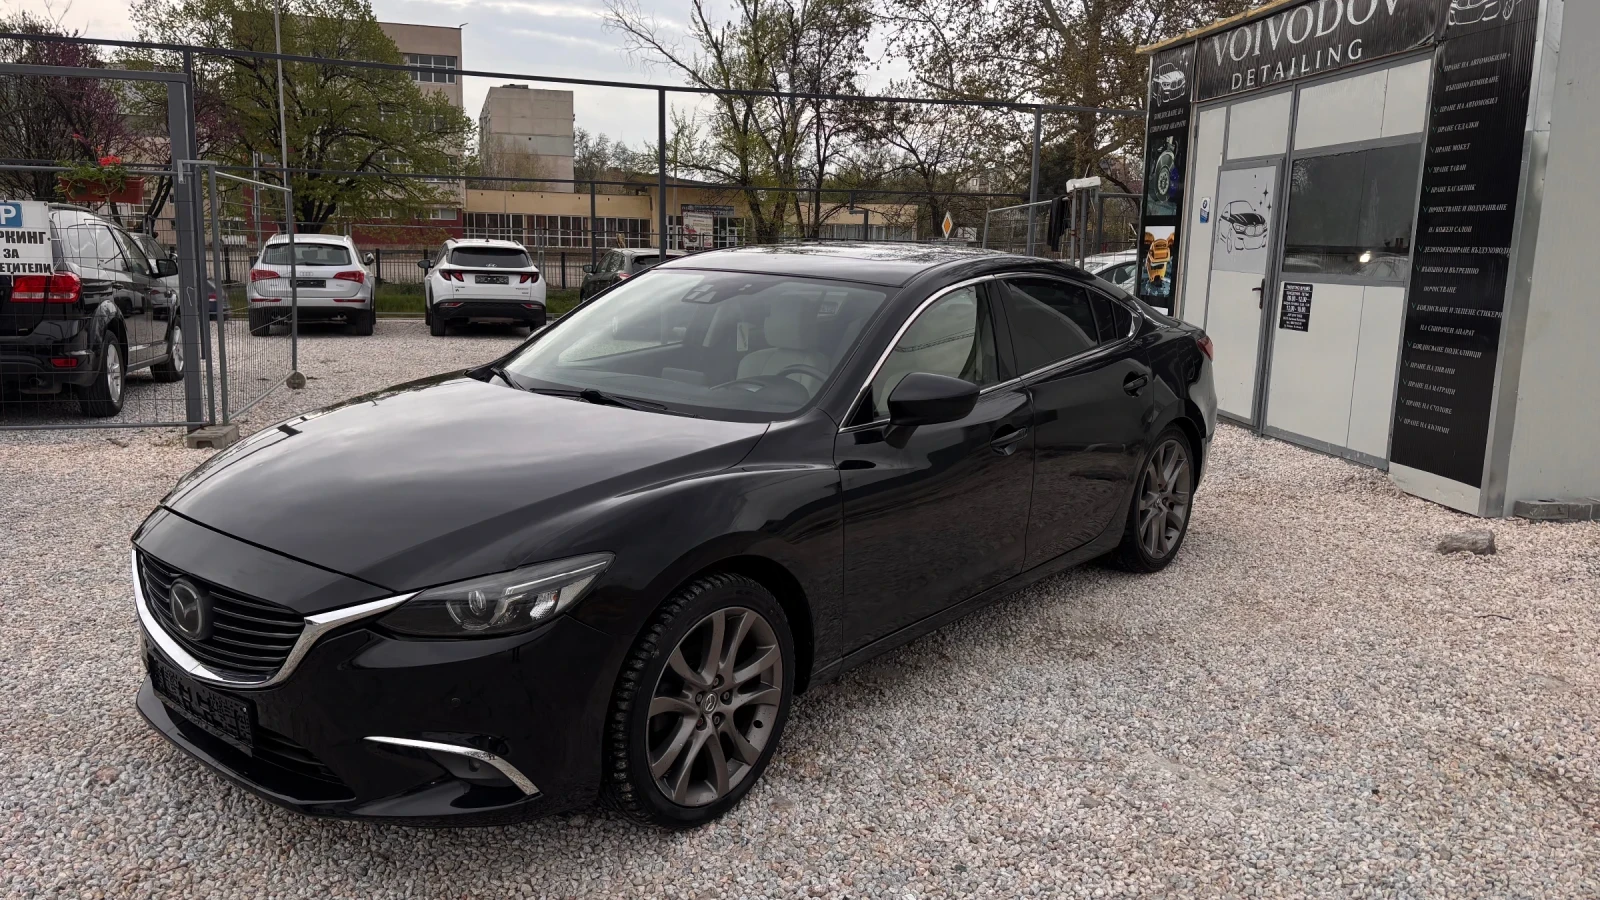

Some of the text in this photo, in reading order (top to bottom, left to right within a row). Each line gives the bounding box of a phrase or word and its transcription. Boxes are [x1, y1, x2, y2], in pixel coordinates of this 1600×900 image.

[1231, 39, 1362, 90] DETAILING
[1444, 63, 1461, 72] ПРАНЕ
[1440, 97, 1498, 112] ПРАНЕ НА АВТОМОБИЛ
[1437, 121, 1479, 133] ПРАНЕ СЕДАЛКИ
[1434, 143, 1471, 153] ПРАНЕ МОКЕТ
[1433, 164, 1466, 173] ПРАНЕ ТАВАН
[1428, 205, 1462, 213] ПОЧИСТВАНЕ
[0, 205, 17, 225] P
[1454, 225, 1473, 233] САЛОН
[3, 248, 19, 259] ЗА
[1410, 362, 1426, 370] ПРАНЕ
[1407, 380, 1424, 389] ПРАНЕ
[1432, 384, 1456, 395] МАТРАЦИ
[1405, 399, 1421, 408] ПРАНЕ
[1421, 402, 1430, 410] НА
[1403, 418, 1420, 427] ПРАНЕ
